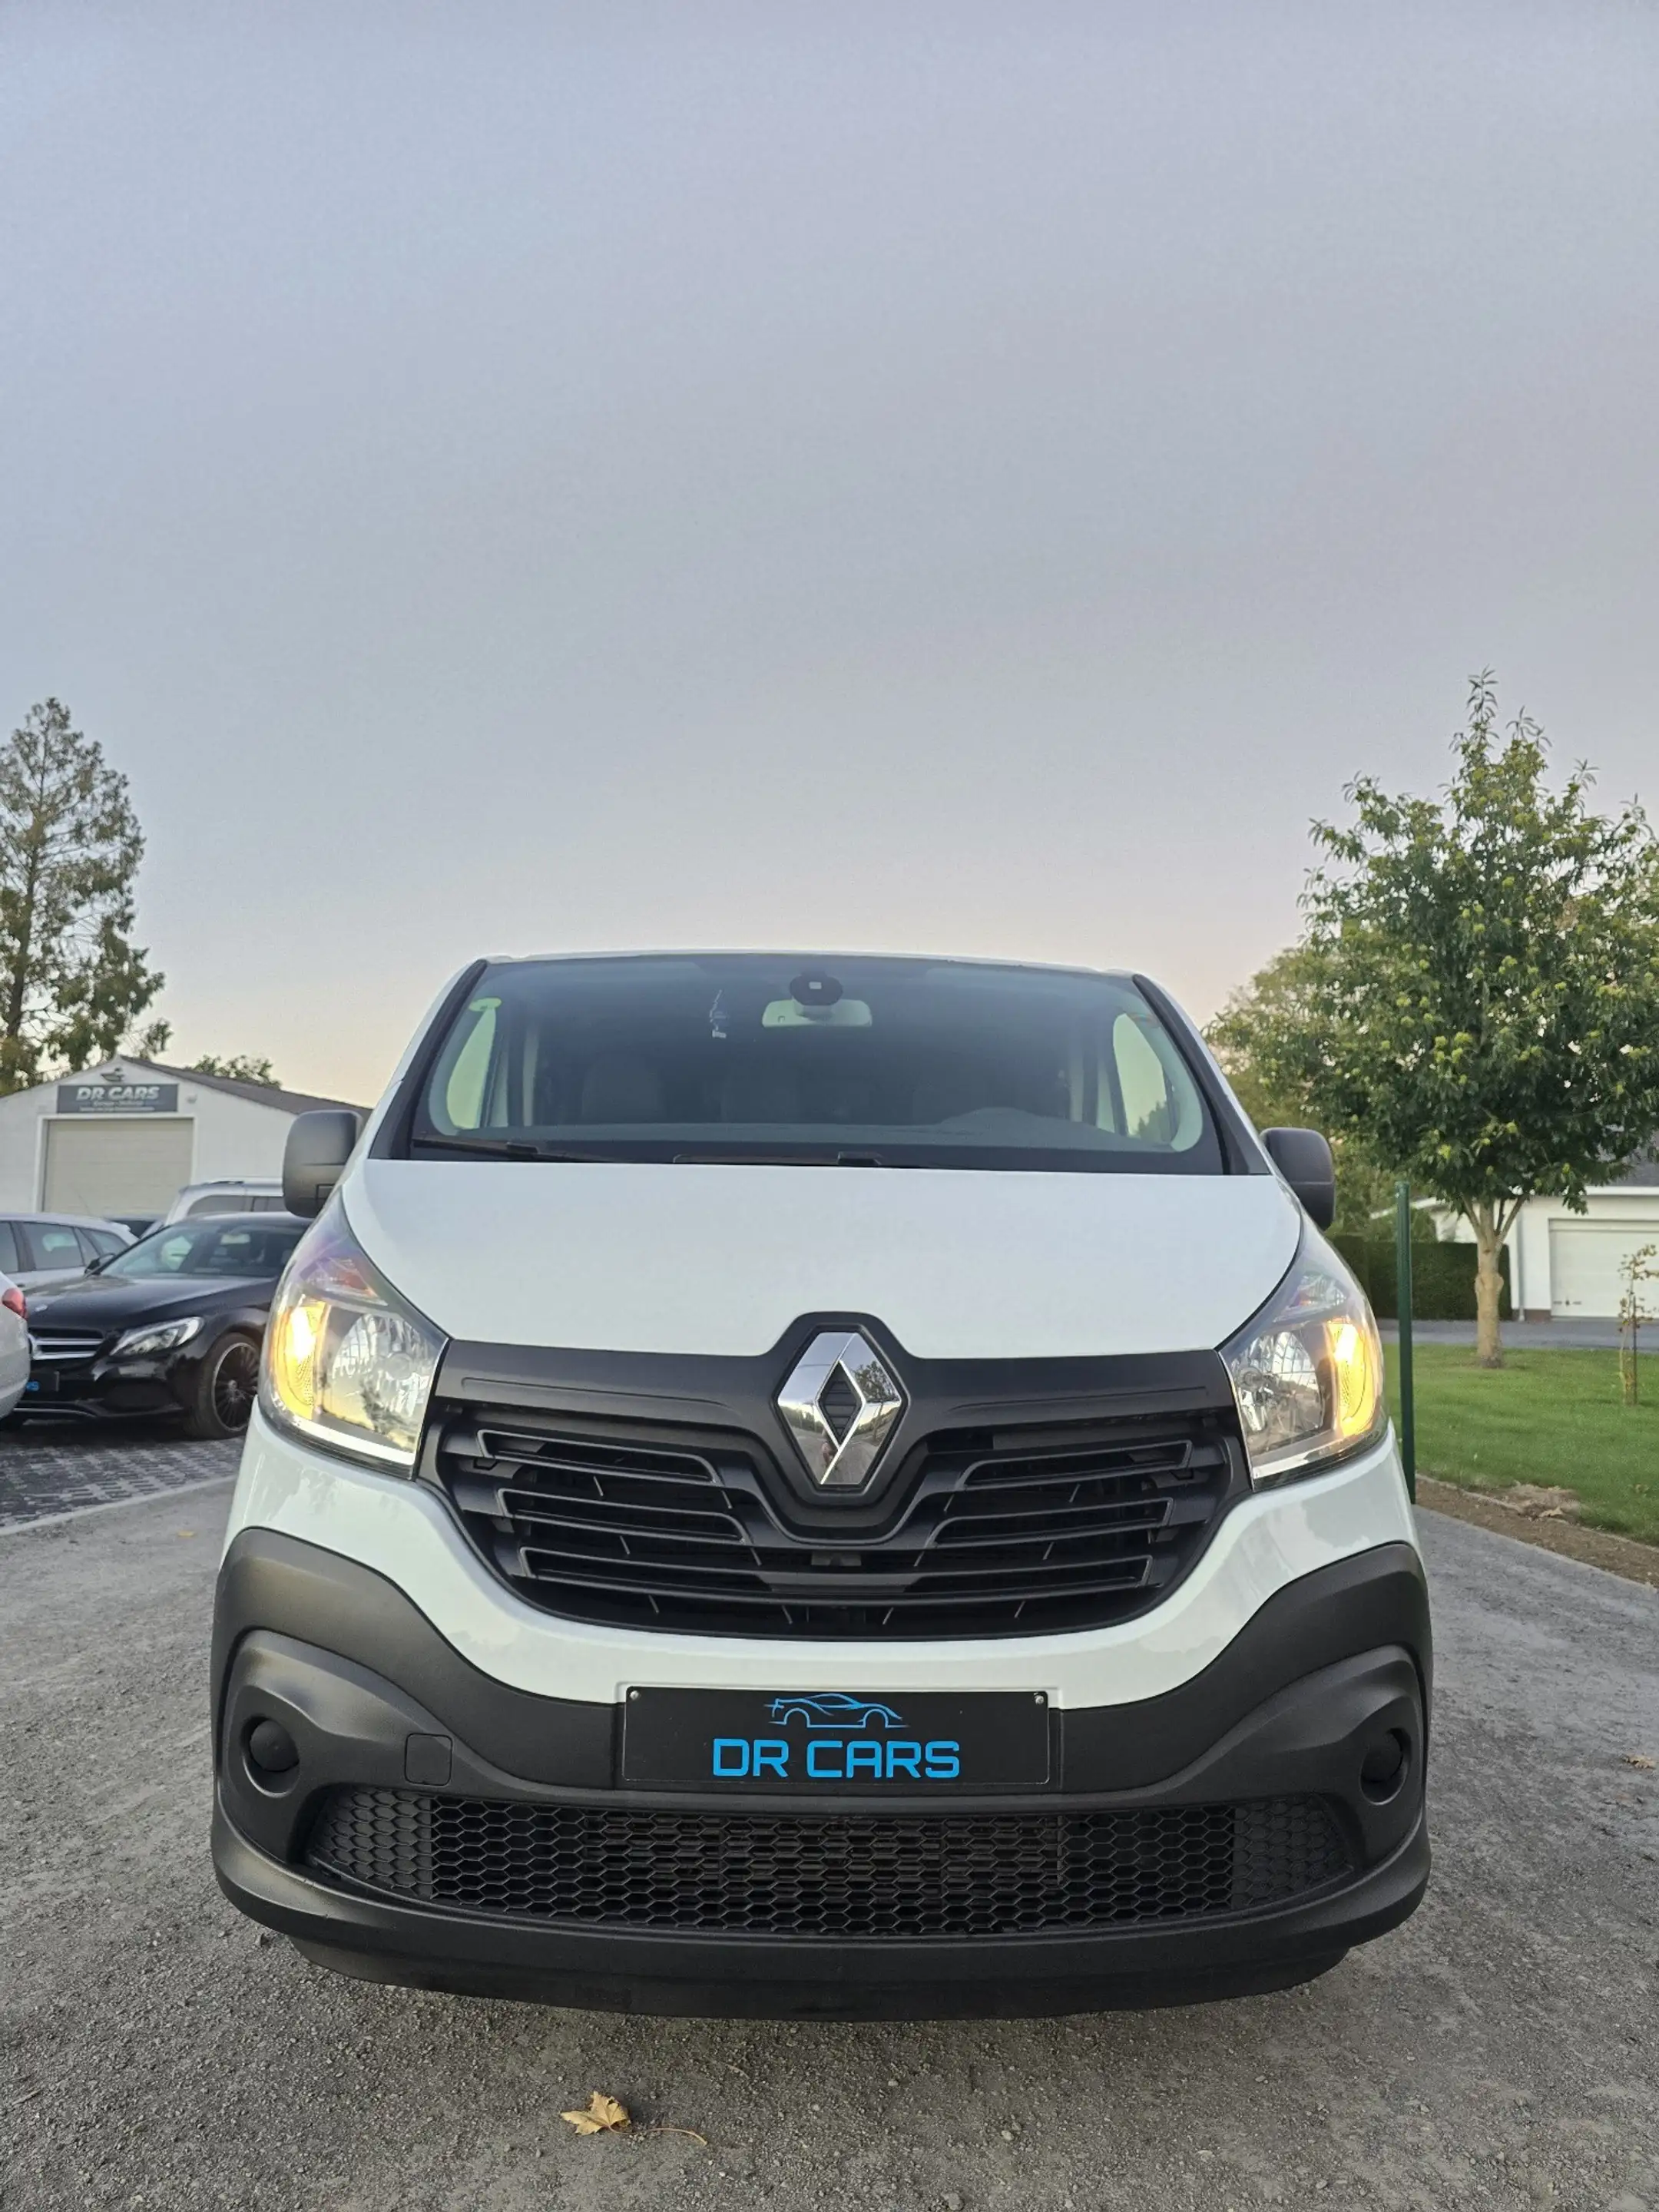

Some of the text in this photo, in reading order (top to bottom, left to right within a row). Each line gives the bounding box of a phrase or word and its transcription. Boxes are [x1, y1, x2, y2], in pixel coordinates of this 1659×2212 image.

[76, 1086, 160, 1101] DR CARS
[712, 1737, 960, 1780] DR CARS
